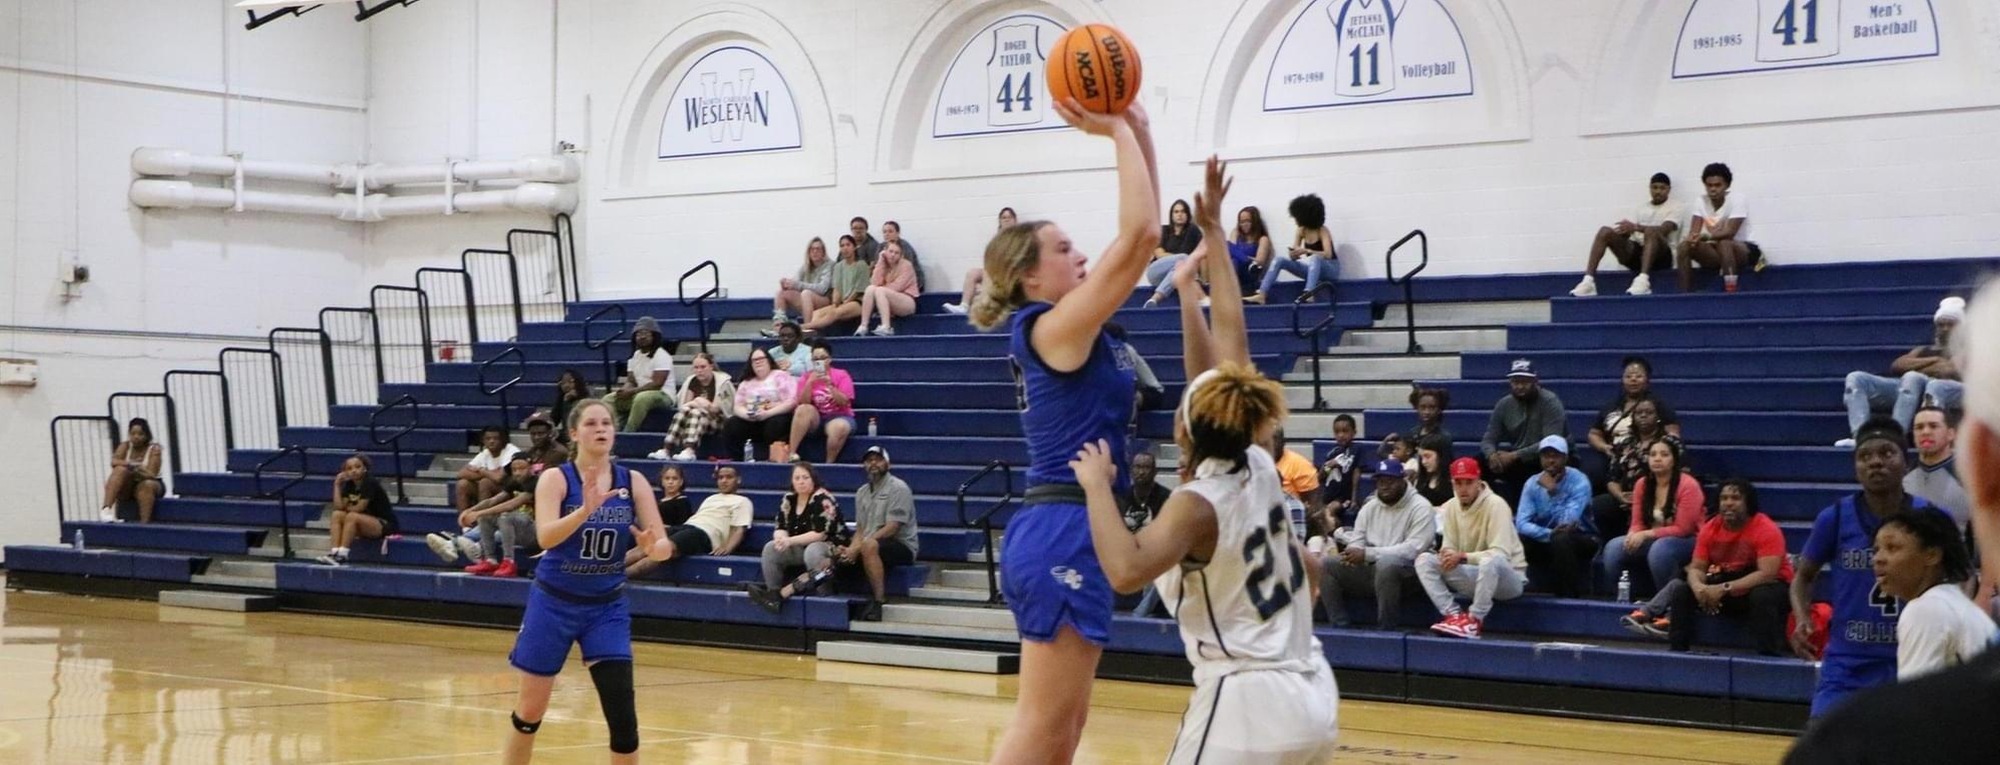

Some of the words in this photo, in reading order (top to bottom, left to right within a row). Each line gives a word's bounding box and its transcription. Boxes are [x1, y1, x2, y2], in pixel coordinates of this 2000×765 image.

[1773, 0, 1818, 46] 41
[1869, 4, 1902, 18] Men's
[1347, 25, 1385, 39] McCLAIN
[1693, 34, 1743, 50] 1981-1985
[1853, 20, 1917, 39] Basketball
[1004, 40, 1026, 51] ROGER
[1000, 53, 1031, 67] TAYLOR
[1349, 42, 1380, 87] 11
[1402, 61, 1455, 79] Volleyball
[1076, 51, 1099, 99] NCAA
[996, 72, 1033, 112] 44
[685, 90, 768, 132] WESLEYAN
[580, 528, 618, 560] 10
[1868, 582, 1898, 616] 4
